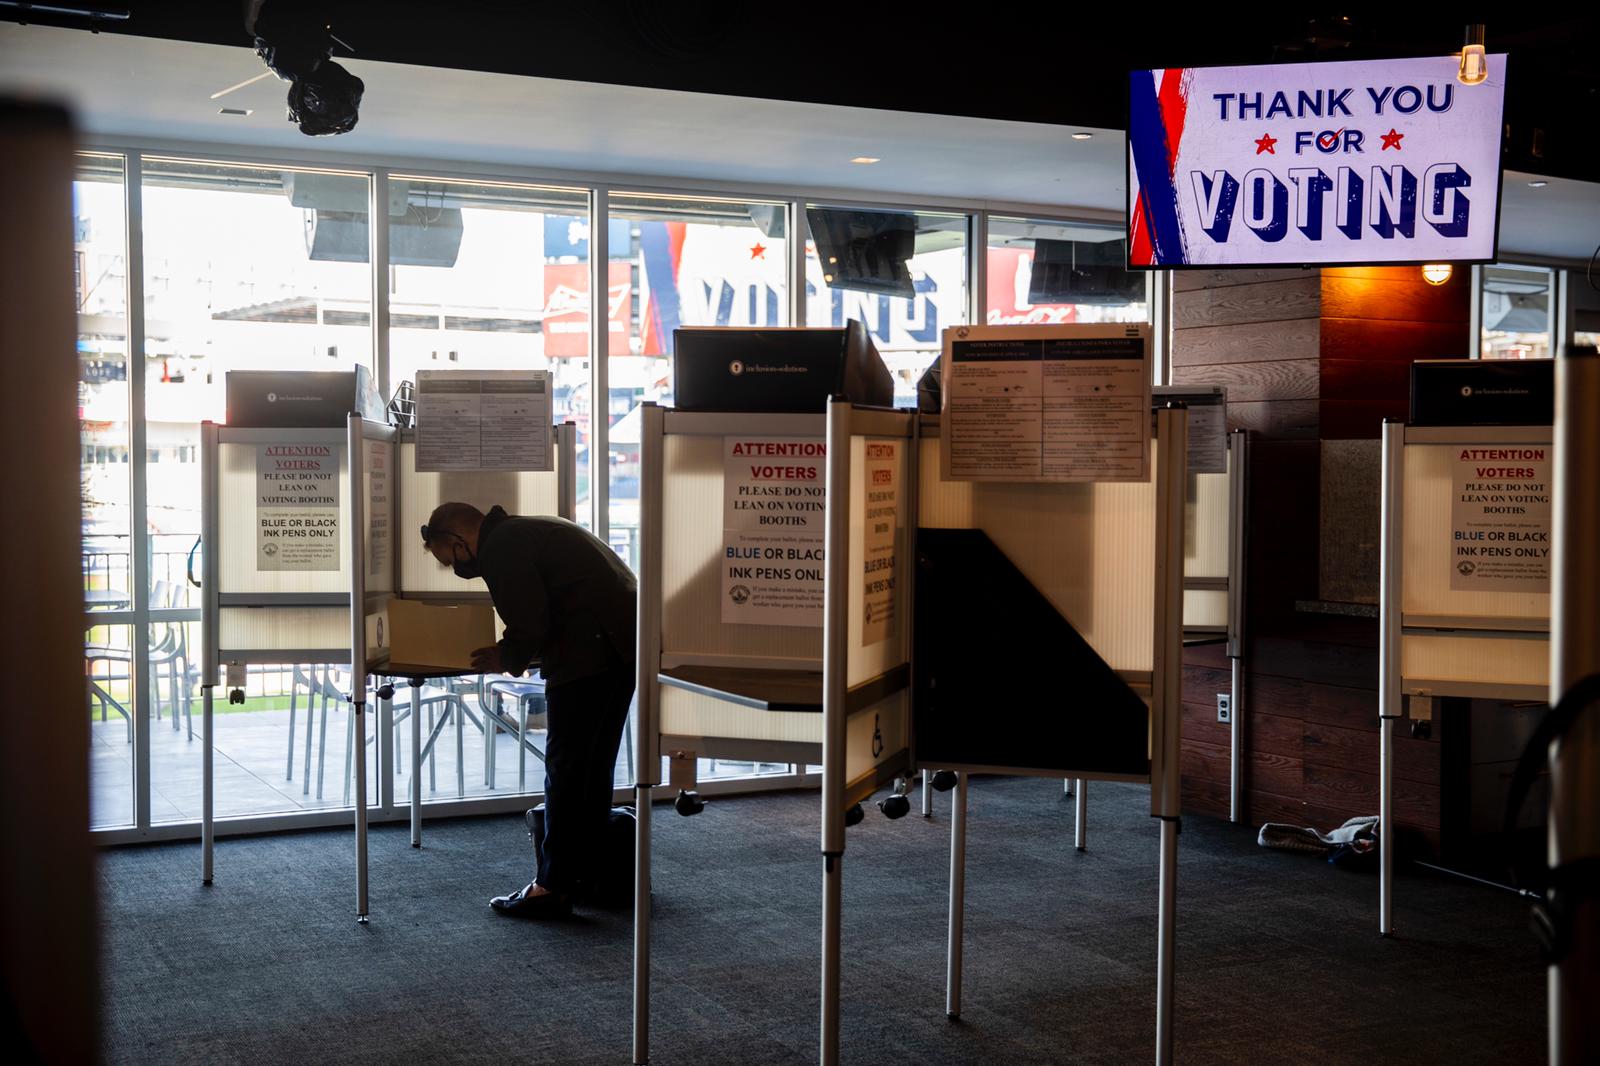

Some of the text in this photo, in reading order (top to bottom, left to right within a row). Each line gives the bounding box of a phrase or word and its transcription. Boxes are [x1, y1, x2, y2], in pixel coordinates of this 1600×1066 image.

[1213, 83, 1454, 120] THANK YOU
[1294, 127, 1364, 155] FOR
[1190, 162, 1472, 243] VOTING
[265, 446, 331, 456] ATTENTION
[732, 442, 827, 456] ATTENTION
[1460, 449, 1545, 460] ATTENTION
[275, 460, 320, 469] VOTERS
[751, 466, 817, 479] VOTERS
[1476, 467, 1535, 478] VOTERS
[739, 486, 782, 496] PLEASE
[785, 487, 802, 496] DO
[1465, 483, 1545, 492] PLEASE DO NOT
[262, 496, 335, 504] VOTING BOOTHS
[1461, 494, 1549, 504] LEAN ON VOTING
[734, 501, 765, 511] LEAN
[767, 501, 784, 511] ON
[1483, 506, 1526, 514] BOOTHS
[261, 519, 337, 527] BLUE OR BLACK
[759, 515, 807, 526] BOOTHS
[263, 529, 335, 537] INK PENS ONLY
[1455, 531, 1548, 542] BLUE OR BLACK
[726, 547, 826, 561] BLUE OR BLAC
[1457, 547, 1549, 558] INK PENS ONLY
[729, 567, 824, 581] INK PENS ONL
